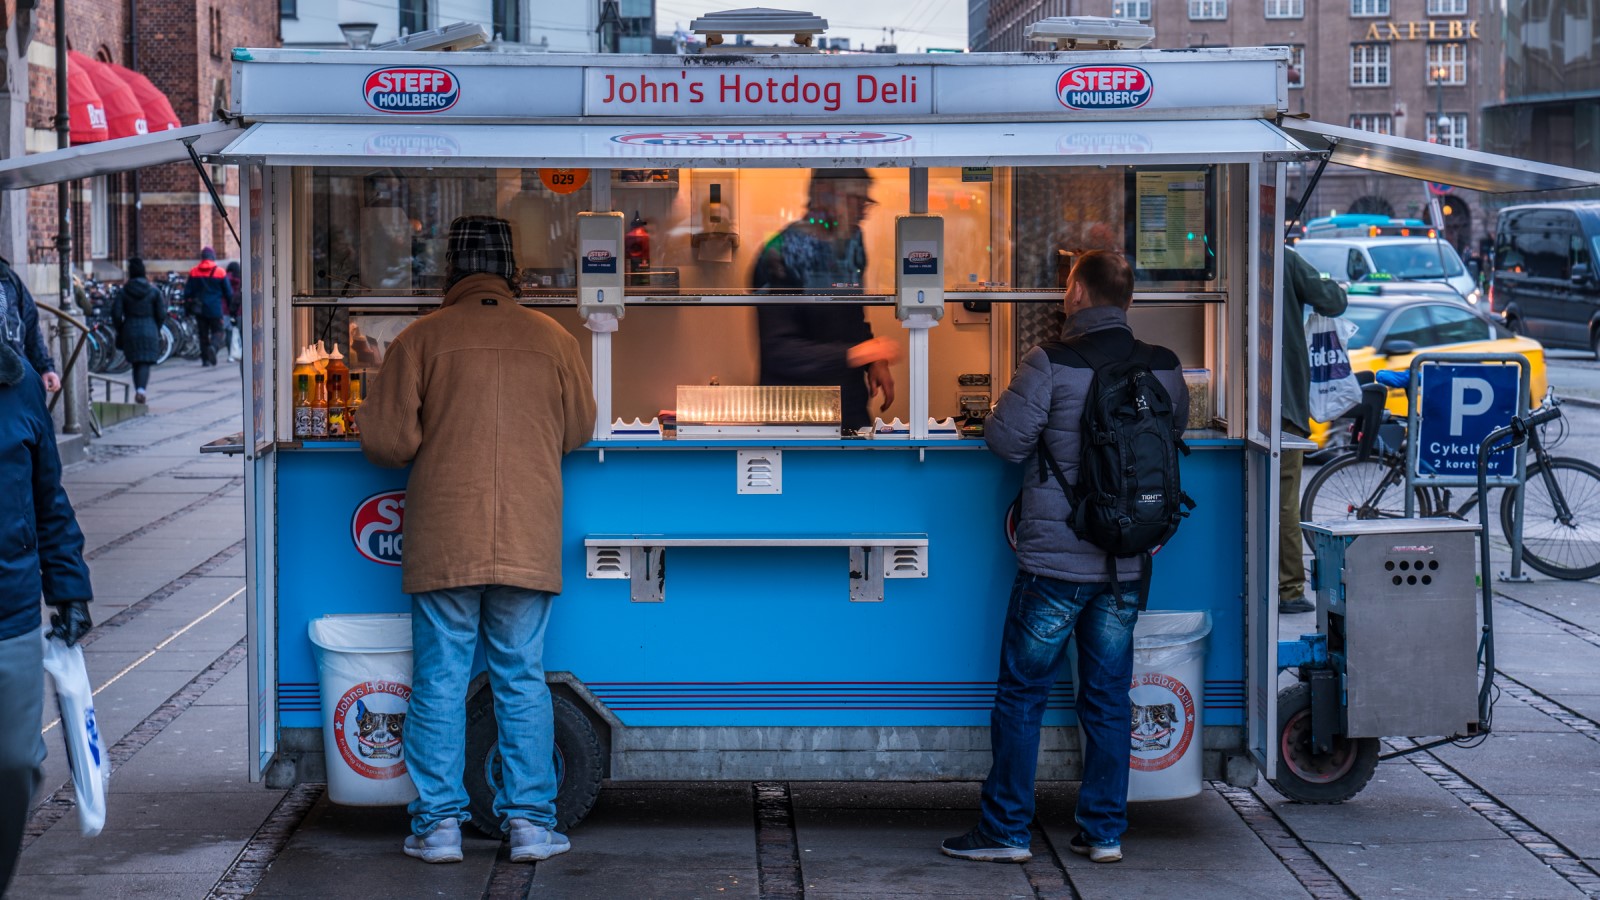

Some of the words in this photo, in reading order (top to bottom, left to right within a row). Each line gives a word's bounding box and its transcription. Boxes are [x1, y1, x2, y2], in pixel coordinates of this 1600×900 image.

[378, 72, 445, 92] STEFF
[1071, 71, 1138, 90] STEFF
[603, 70, 704, 103] John's
[720, 74, 841, 111] Hotdog
[857, 74, 917, 103] Deli
[1072, 92, 1139, 105] HOULBERG
[379, 94, 446, 107] HOULBERG
[661, 132, 862, 140] STEFF
[552, 174, 575, 185] 029
[1450, 377, 1495, 436] P
[1430, 442, 1505, 456] Cykeltxi
[1434, 459, 1441, 468] 2
[1446, 460, 1499, 469] køreter
[377, 498, 405, 532] S
[337, 687, 364, 717] Johns
[1176, 685, 1193, 708] Deli
